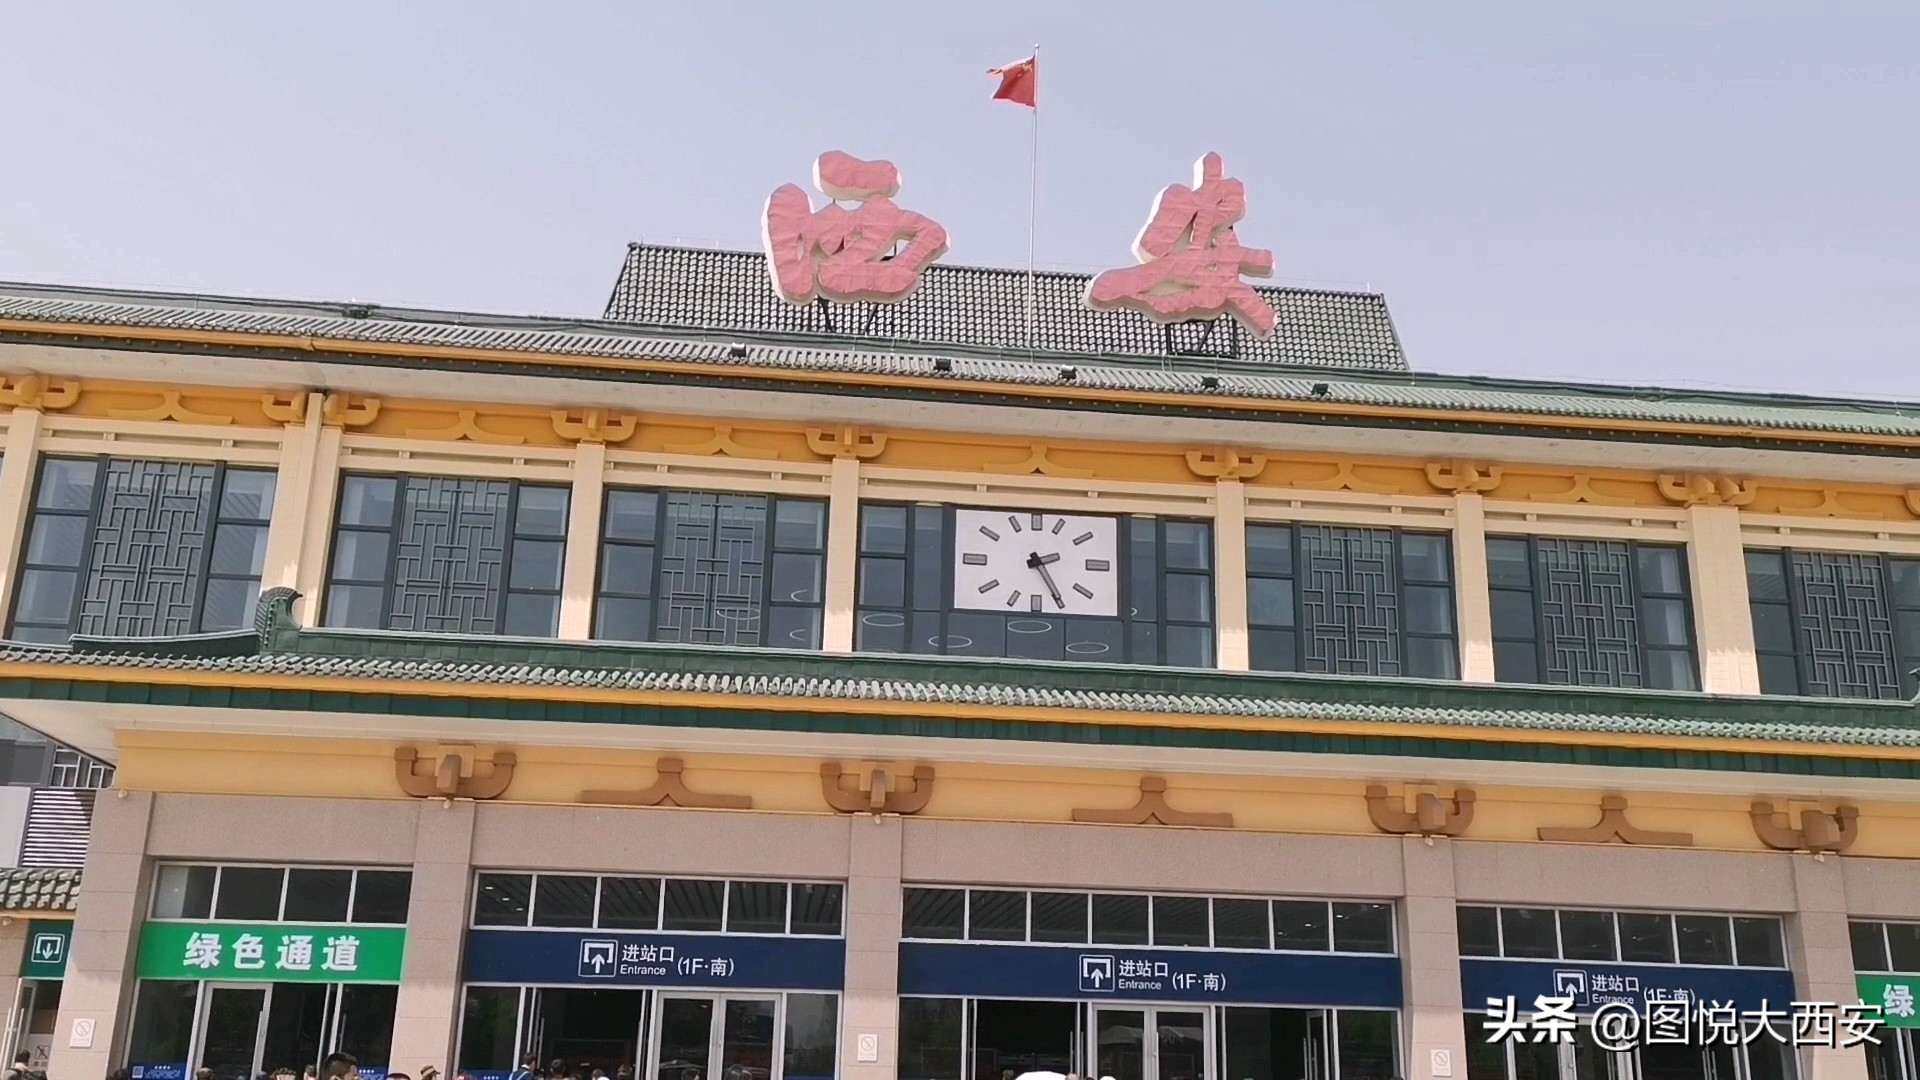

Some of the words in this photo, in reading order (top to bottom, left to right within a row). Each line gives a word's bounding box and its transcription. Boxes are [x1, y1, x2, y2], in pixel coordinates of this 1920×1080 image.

[183, 932, 360, 971] 绿色通道
[621, 944, 675, 962] 进站口
[620, 964, 667, 976] Entrance
[1119, 960, 1169, 977] 进站口
[1118, 979, 1162, 990] Entrance
[1591, 974, 1640, 992] 进站口
[1592, 994, 1634, 1004] Entrance
[1883, 984, 1915, 1017] 绿
